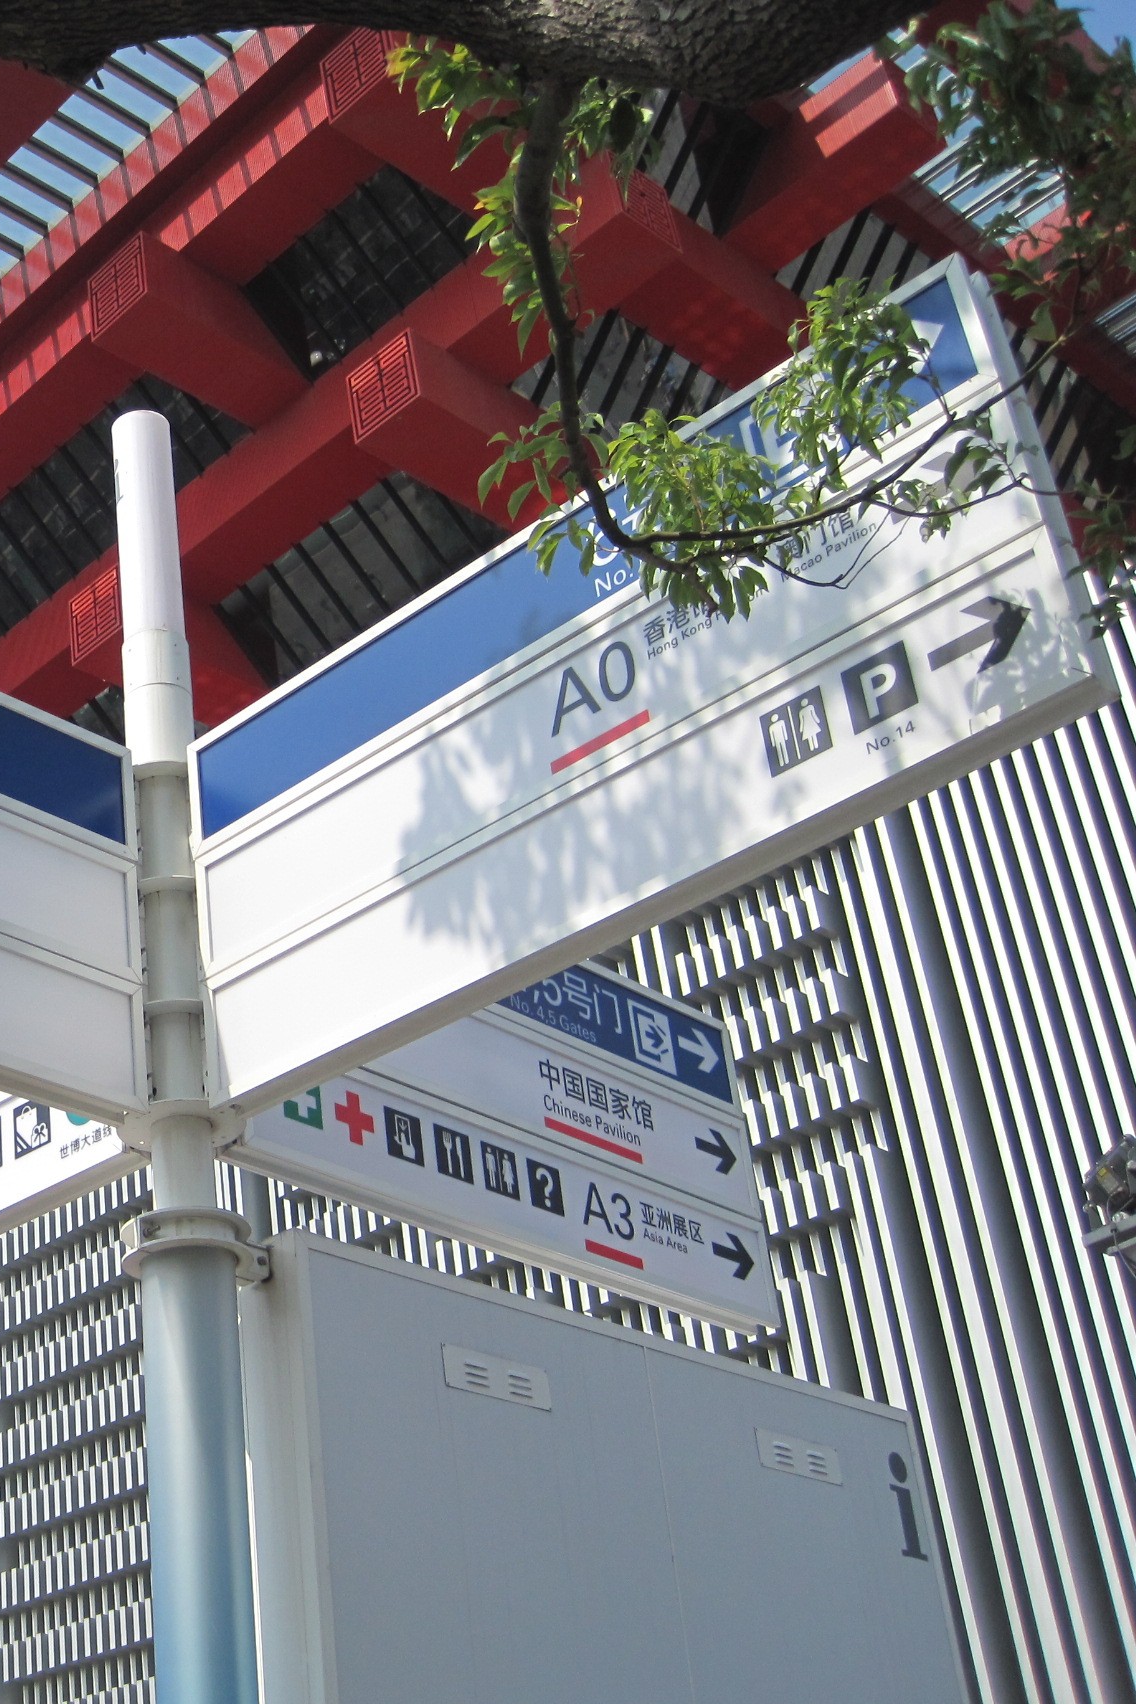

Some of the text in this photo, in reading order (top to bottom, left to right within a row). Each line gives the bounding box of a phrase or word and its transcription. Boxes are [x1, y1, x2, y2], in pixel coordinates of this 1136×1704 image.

[825, 521, 878, 557] Pavilion
[646, 618, 713, 660] Hong Kong
[865, 721, 916, 755] No.14
[521, 971, 622, 1035] ,5号门
[559, 1014, 597, 1044] Gates
[538, 1058, 654, 1132] 中国国家馆
[543, 1094, 642, 1147] Chinese Pavilion
[583, 1181, 635, 1241] A3
[639, 1200, 705, 1246] 亚洲展区
[643, 1228, 689, 1255] Asia Area
